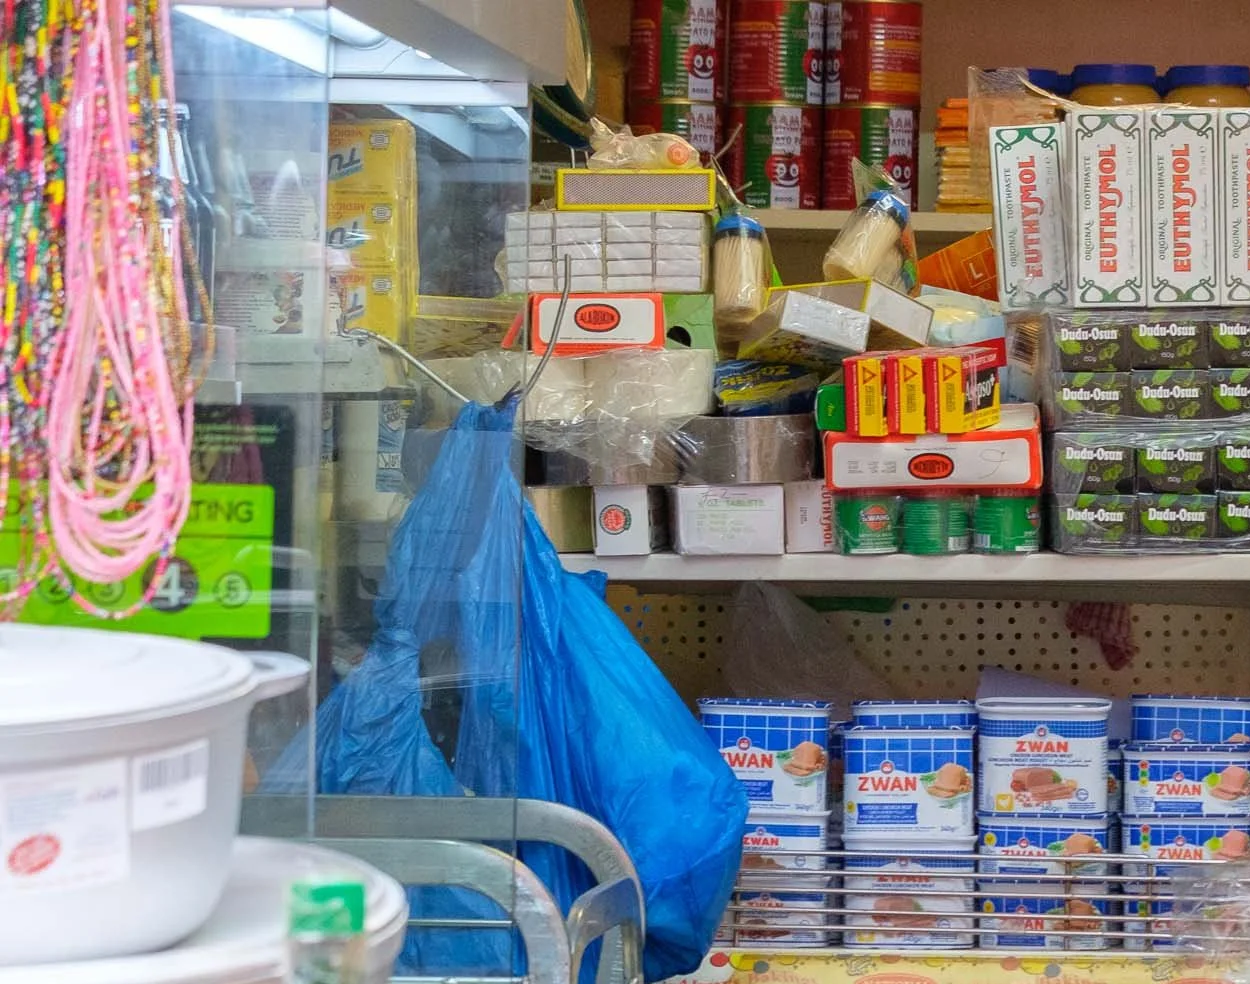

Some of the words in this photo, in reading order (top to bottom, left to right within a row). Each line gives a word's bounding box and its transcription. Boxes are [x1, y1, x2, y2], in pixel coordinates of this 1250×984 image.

[1083, 155, 1093, 211] TOOTHPASTE
[1158, 154, 1166, 211] TOOTHPASTE
[1231, 153, 1240, 209] TOOTHPASTE
[1003, 167, 1013, 219] TOOTHPASTE
[1098, 143, 1124, 273] EUTHYMOL
[1171, 143, 1198, 273] EUTHYMOL
[1017, 155, 1045, 278] EUTHYMOL
[1084, 219, 1093, 261] ORIGINAL
[1158, 218, 1168, 261] ORIGINAL
[1232, 216, 1242, 260] ORIGINAL
[1060, 327, 1118, 341] Dudu-Osun
[1139, 323, 1196, 337] Dudu-Osun
[1062, 387, 1120, 401] Dudu-Osun
[1142, 385, 1199, 399] Dudu-Osun
[1065, 446, 1123, 461] Dudu-Osun
[1146, 447, 1203, 462] Dudu-Osun
[1066, 507, 1124, 522] Dudu-Osun
[1148, 507, 1206, 522] Dudu-Osun
[156, 562, 185, 608] 4
[1015, 740, 1069, 753] ZWAN
[721, 752, 773, 769] WAN
[857, 776, 917, 792] ZWAN
[1156, 783, 1202, 796] ZWAN
[743, 837, 779, 846] ZWAN
[1158, 848, 1203, 860] ZWAN
